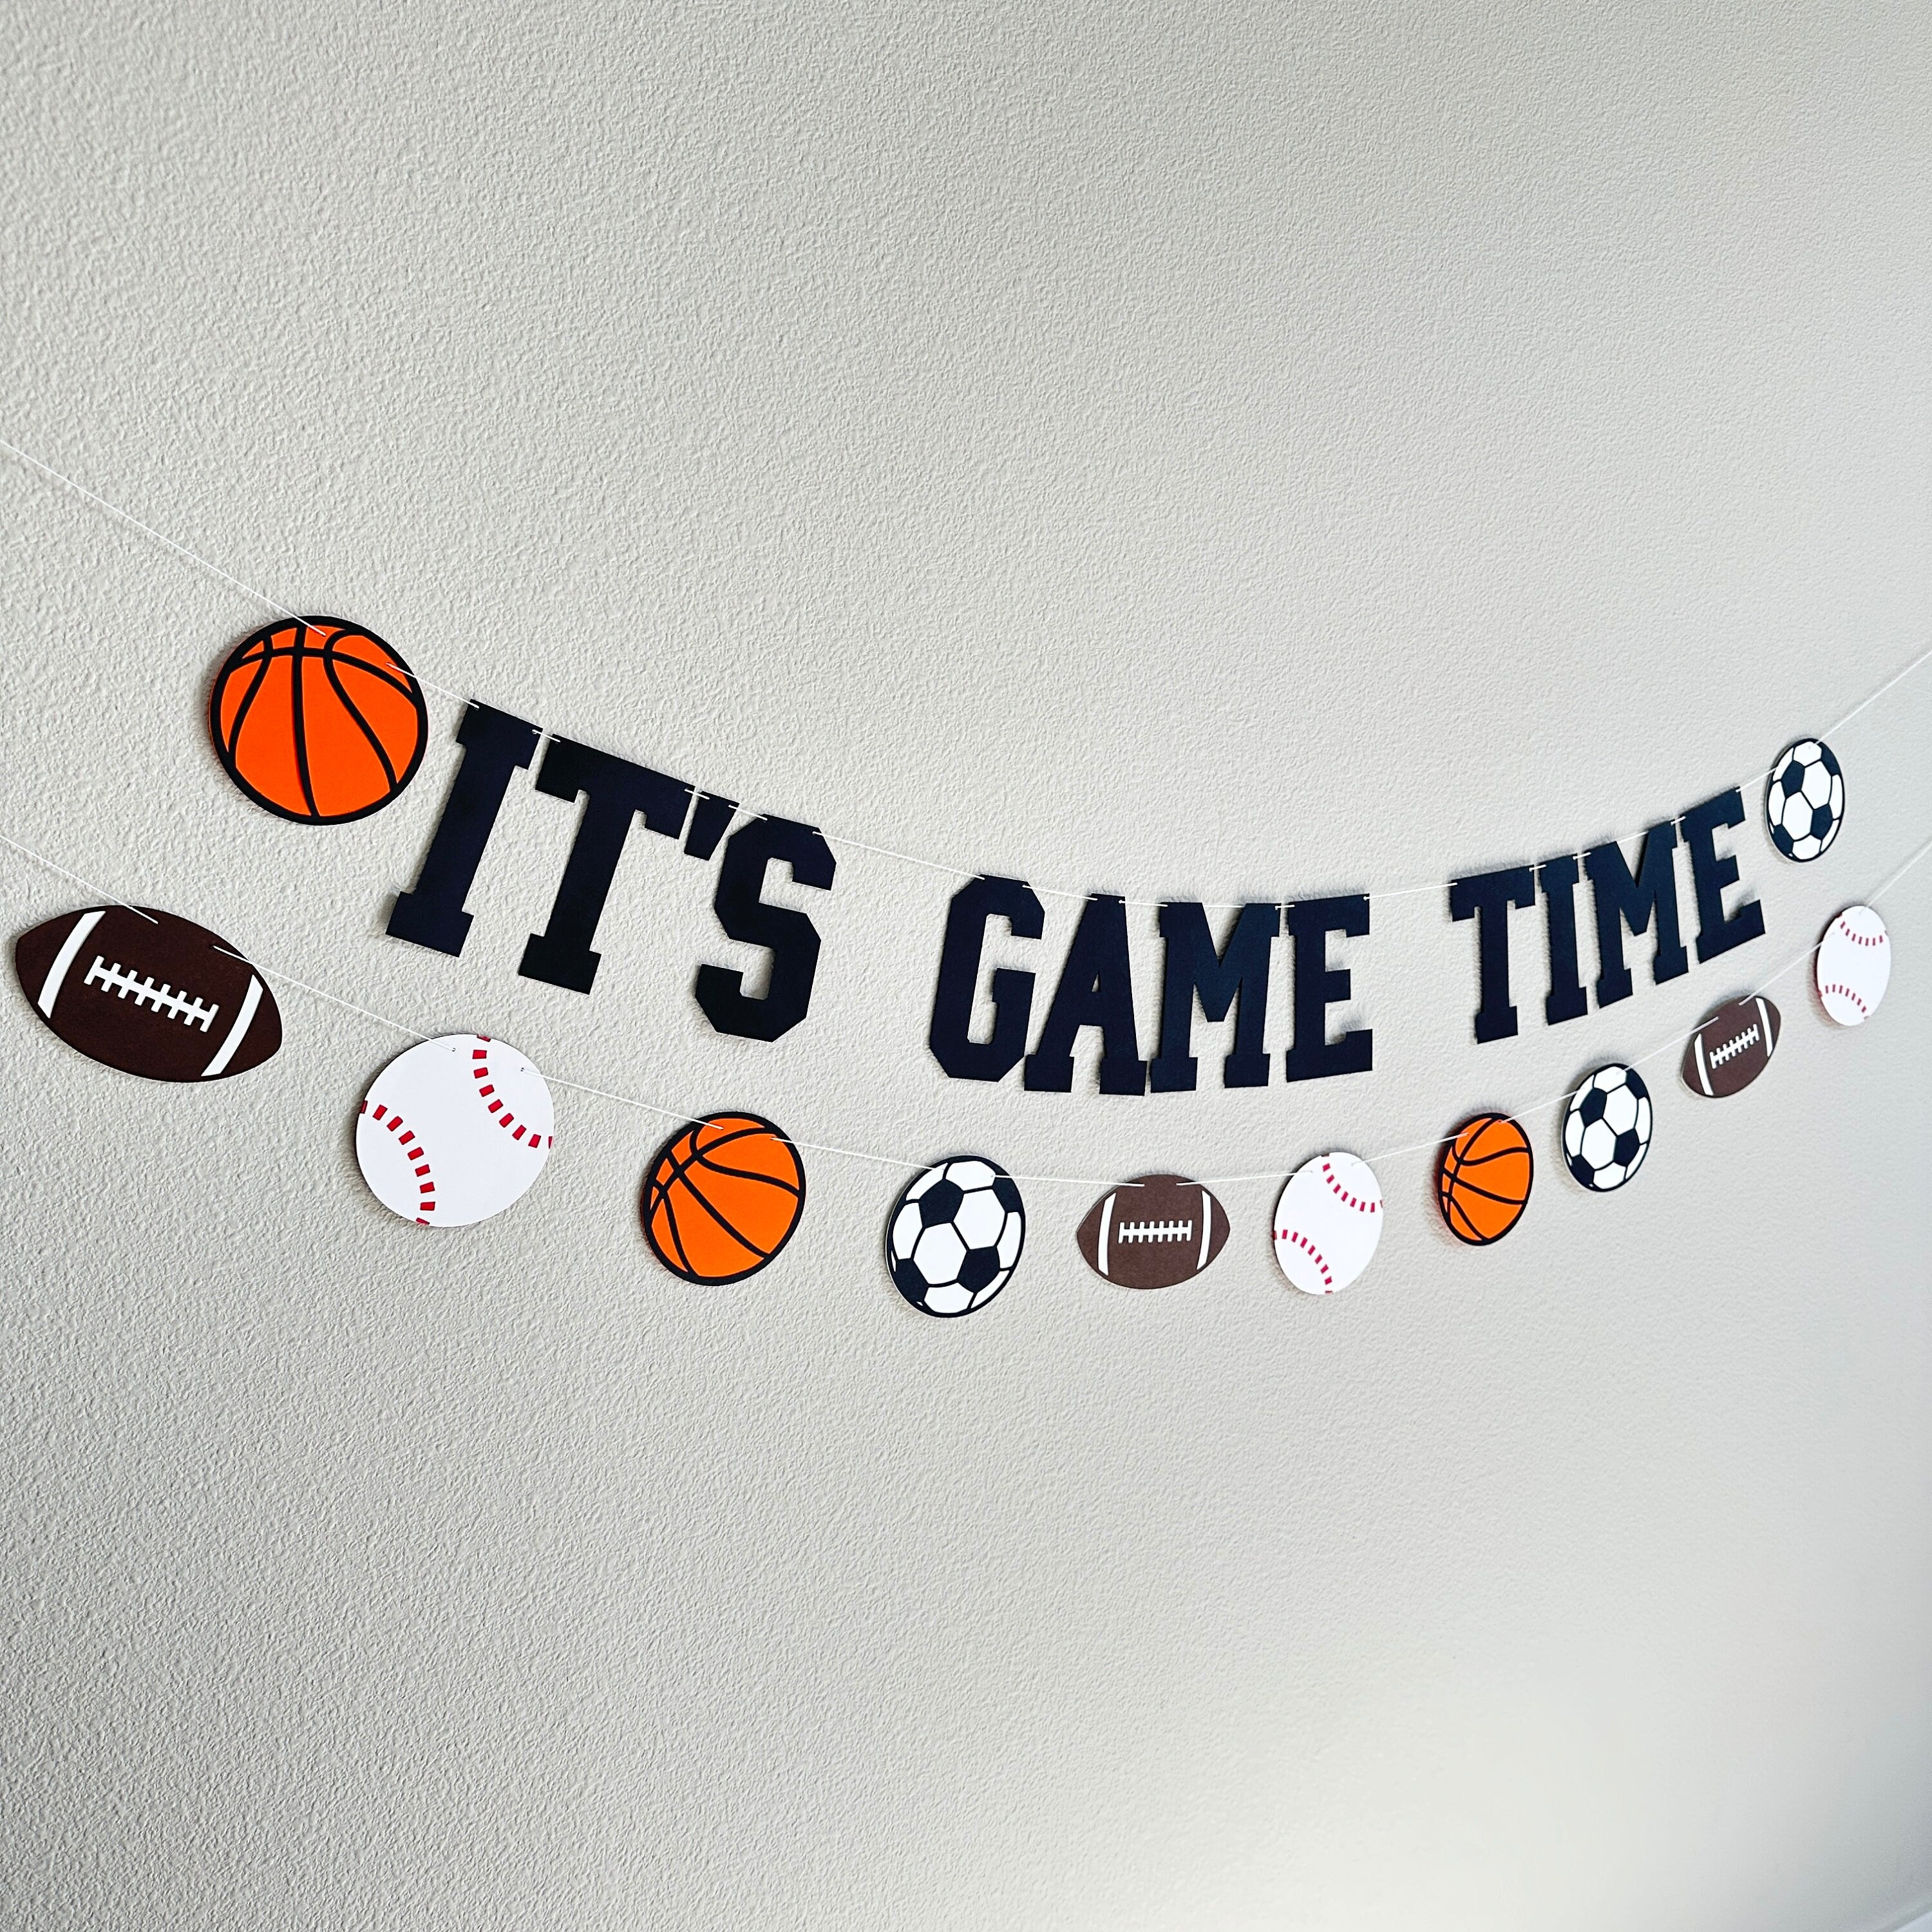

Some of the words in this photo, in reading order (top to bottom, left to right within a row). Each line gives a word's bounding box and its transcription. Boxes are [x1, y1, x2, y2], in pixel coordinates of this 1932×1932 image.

[385, 699, 837, 1043] IT'S
[929, 874, 1373, 1096] GAME
[1448, 786, 1766, 1045] TIME
